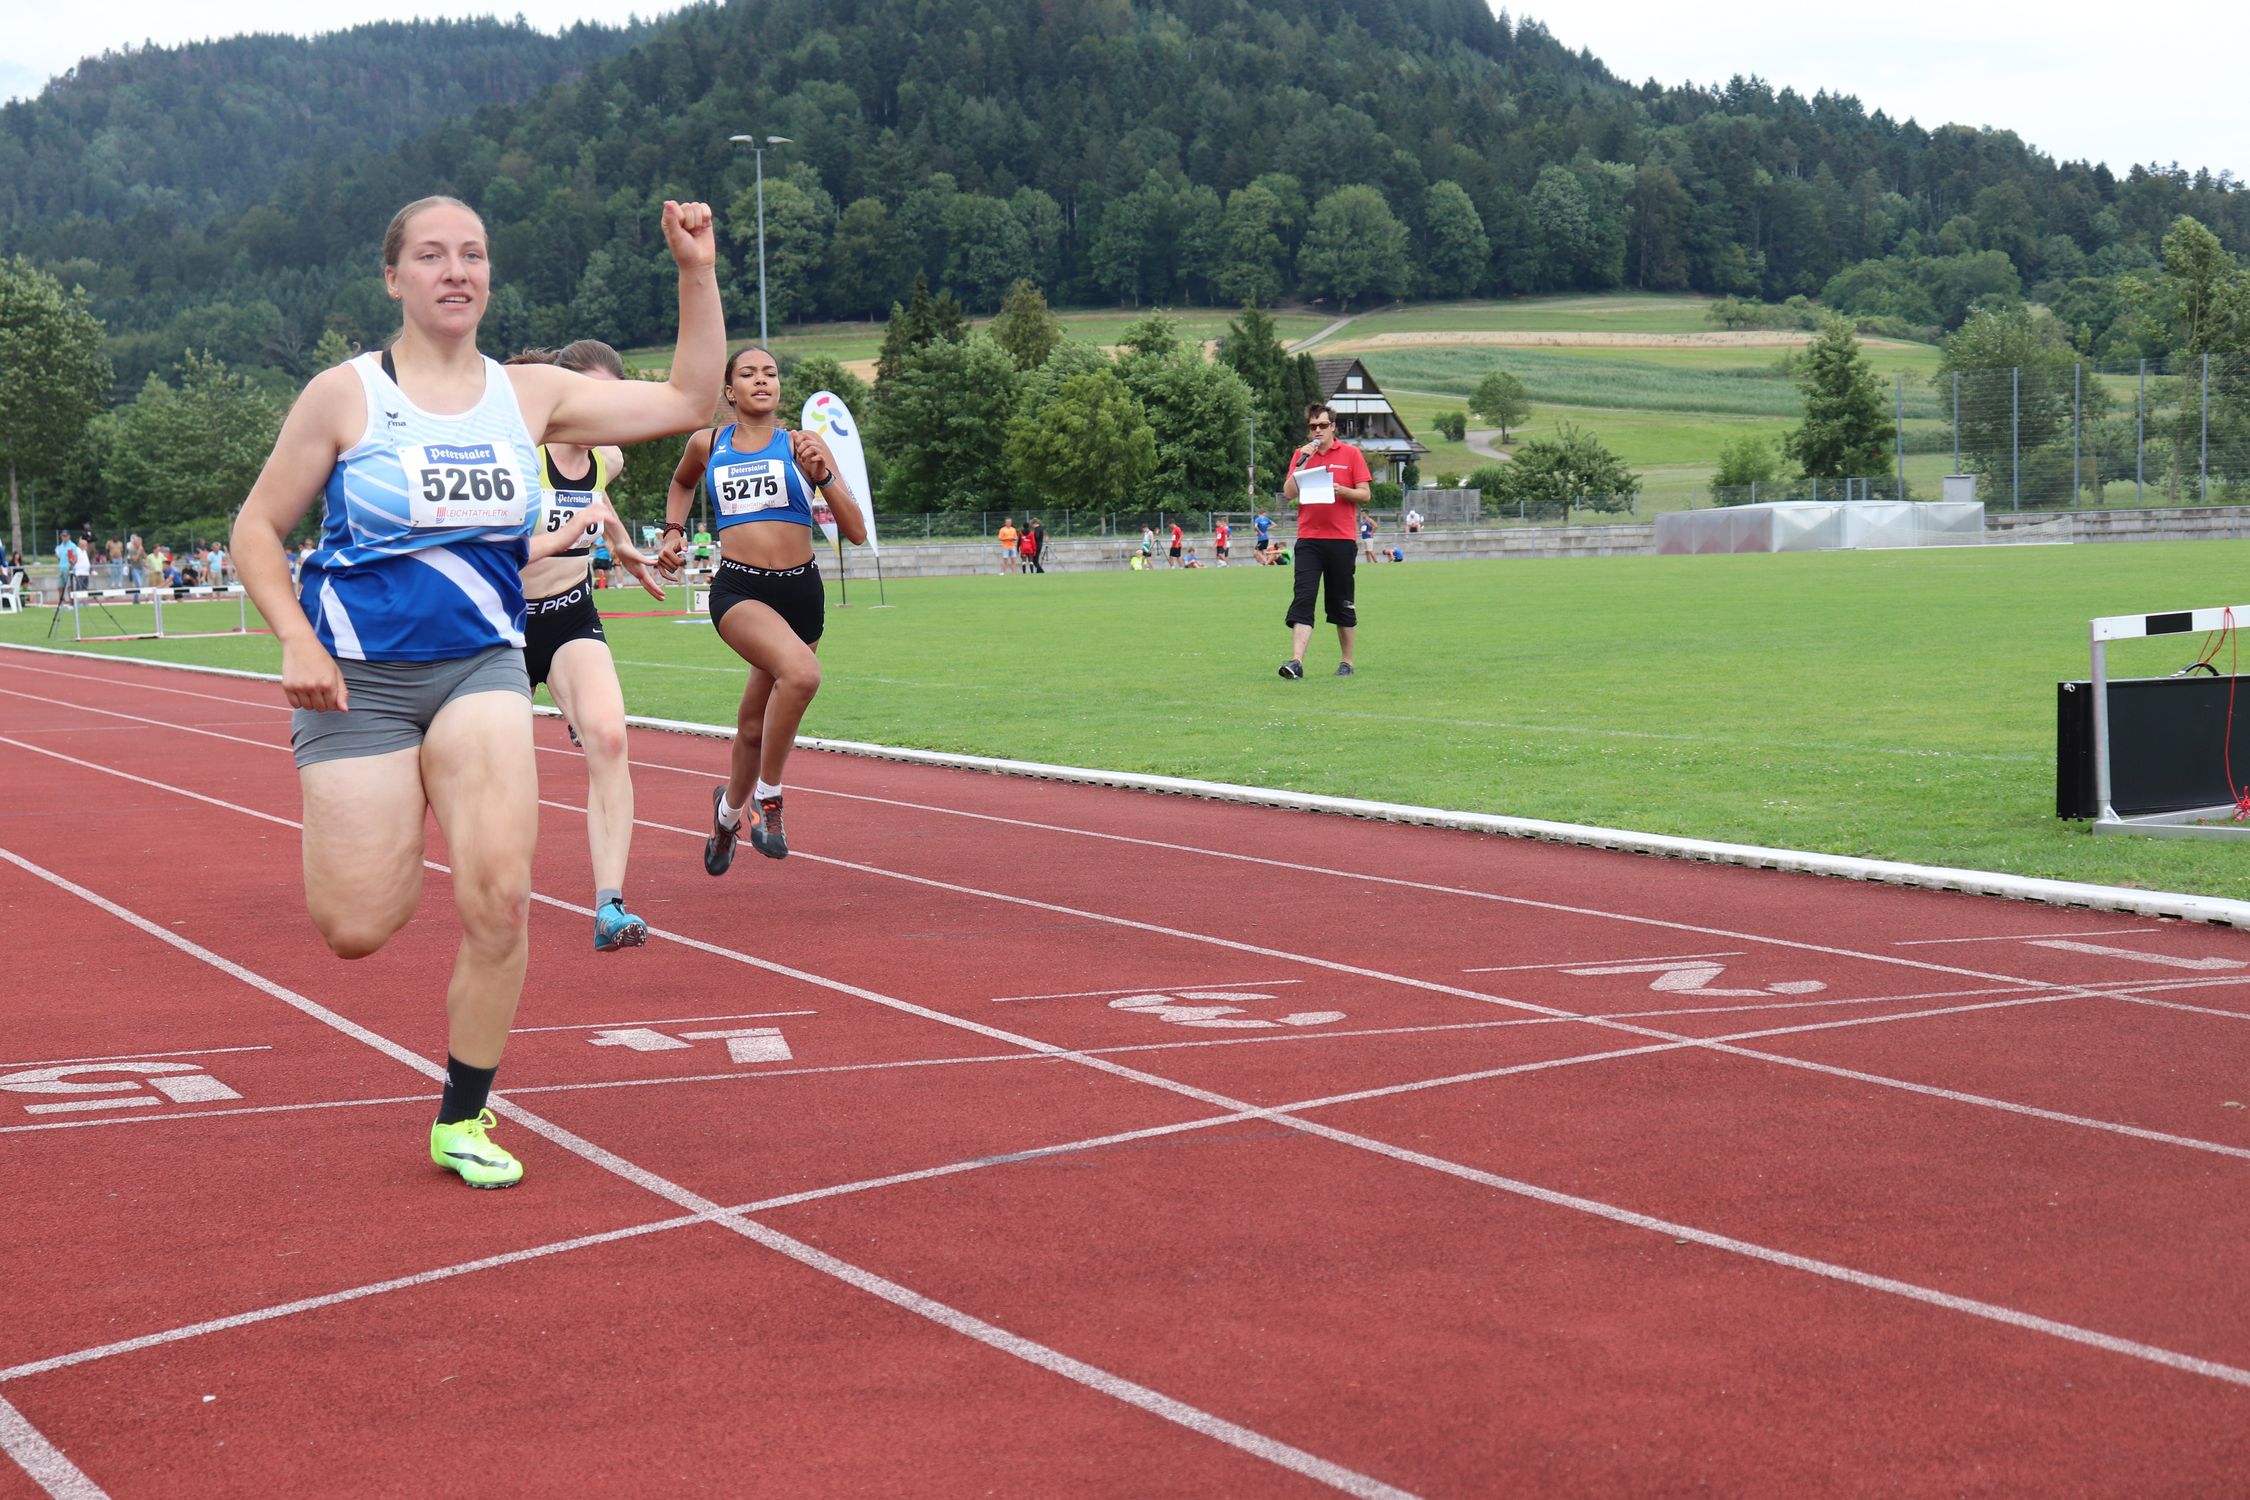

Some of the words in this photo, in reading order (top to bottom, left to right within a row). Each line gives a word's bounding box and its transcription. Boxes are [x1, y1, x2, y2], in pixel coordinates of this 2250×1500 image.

[431, 447, 491, 460] Peterstaler
[730, 464, 767, 476] Peterstaler
[420, 467, 515, 502] 5266
[722, 475, 778, 501] 5275
[722, 560, 761, 575] NIKE
[765, 567, 805, 577] PRO
[541, 589, 582, 614] PRO
[1558, 960, 1828, 996] 2
[1108, 992, 1347, 1028] 3
